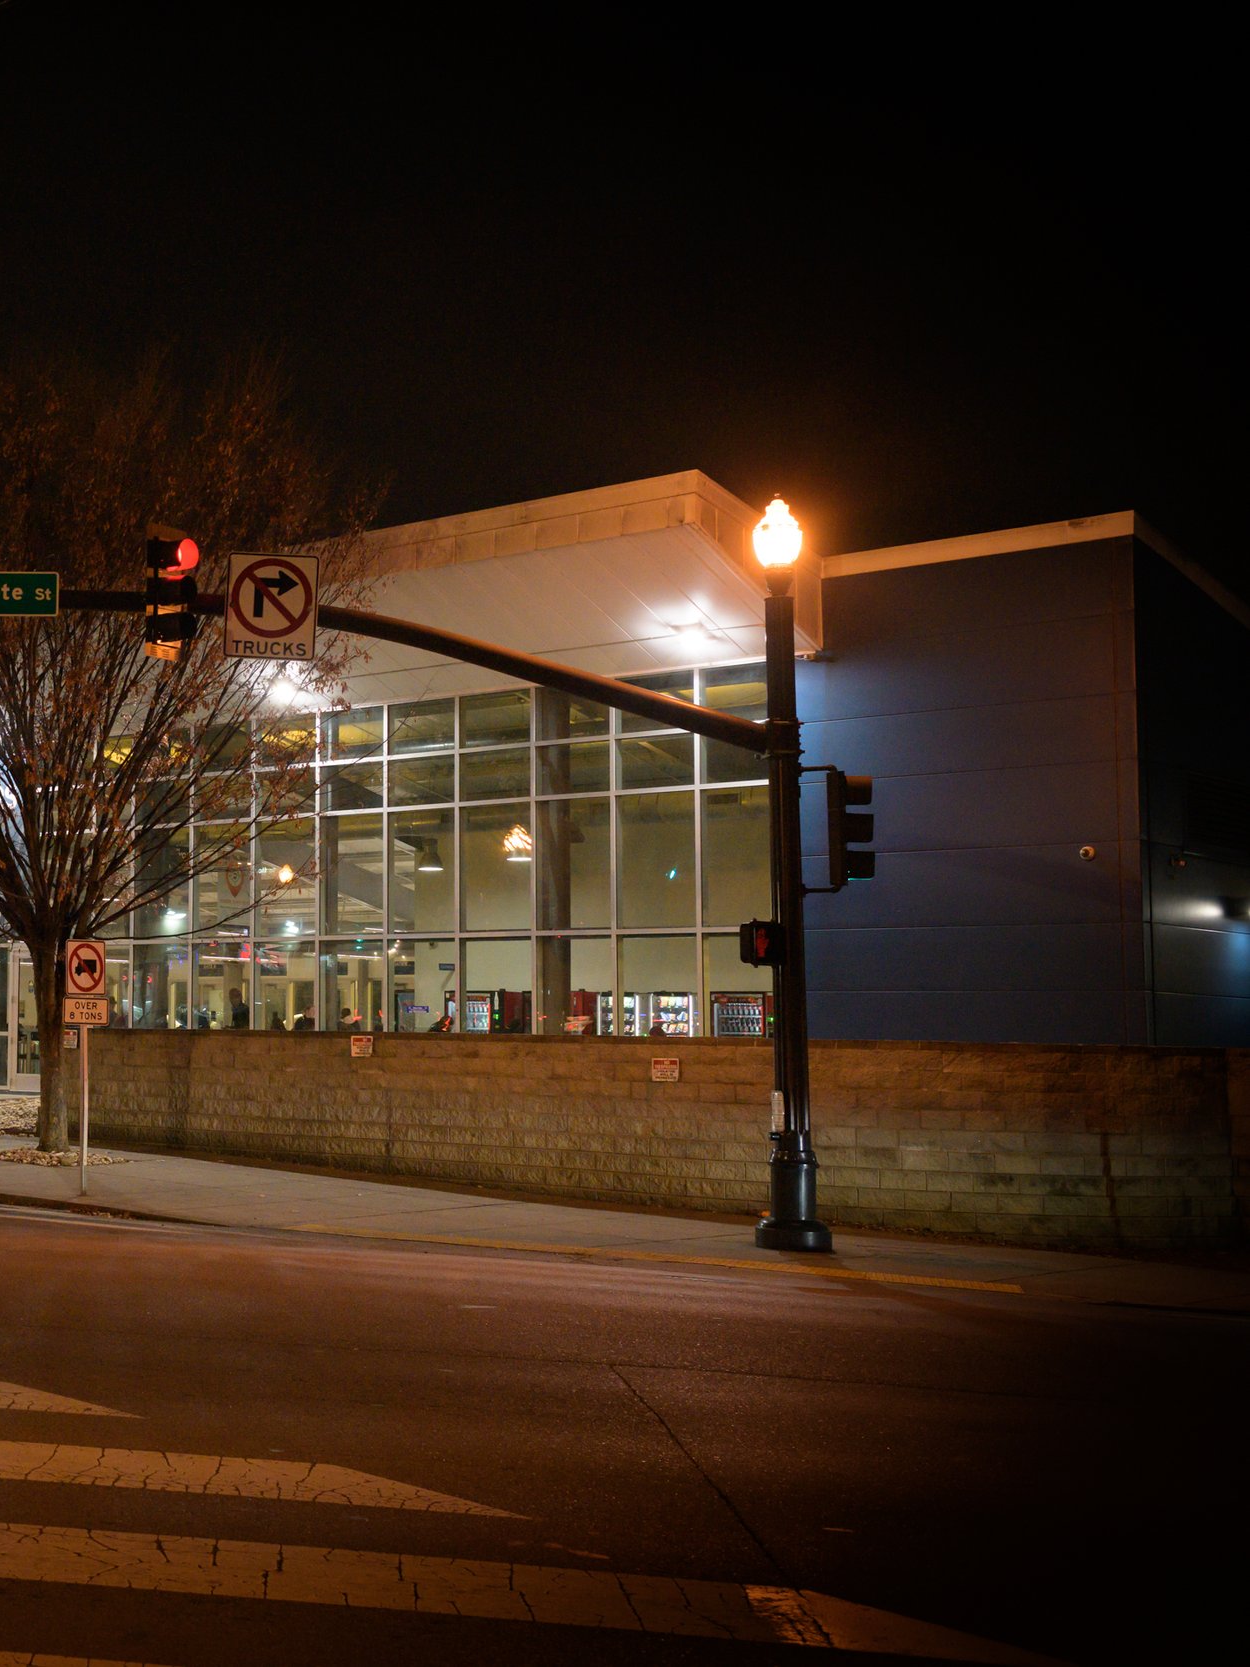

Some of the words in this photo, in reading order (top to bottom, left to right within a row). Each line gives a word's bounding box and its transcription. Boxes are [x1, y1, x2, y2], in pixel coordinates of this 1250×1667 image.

[35, 587, 52, 600] St
[232, 639, 307, 656] TRUCKS
[74, 1001, 98, 1010] OVER
[69, 1012, 75, 1020] 8
[80, 1012, 103, 1020] TONS
